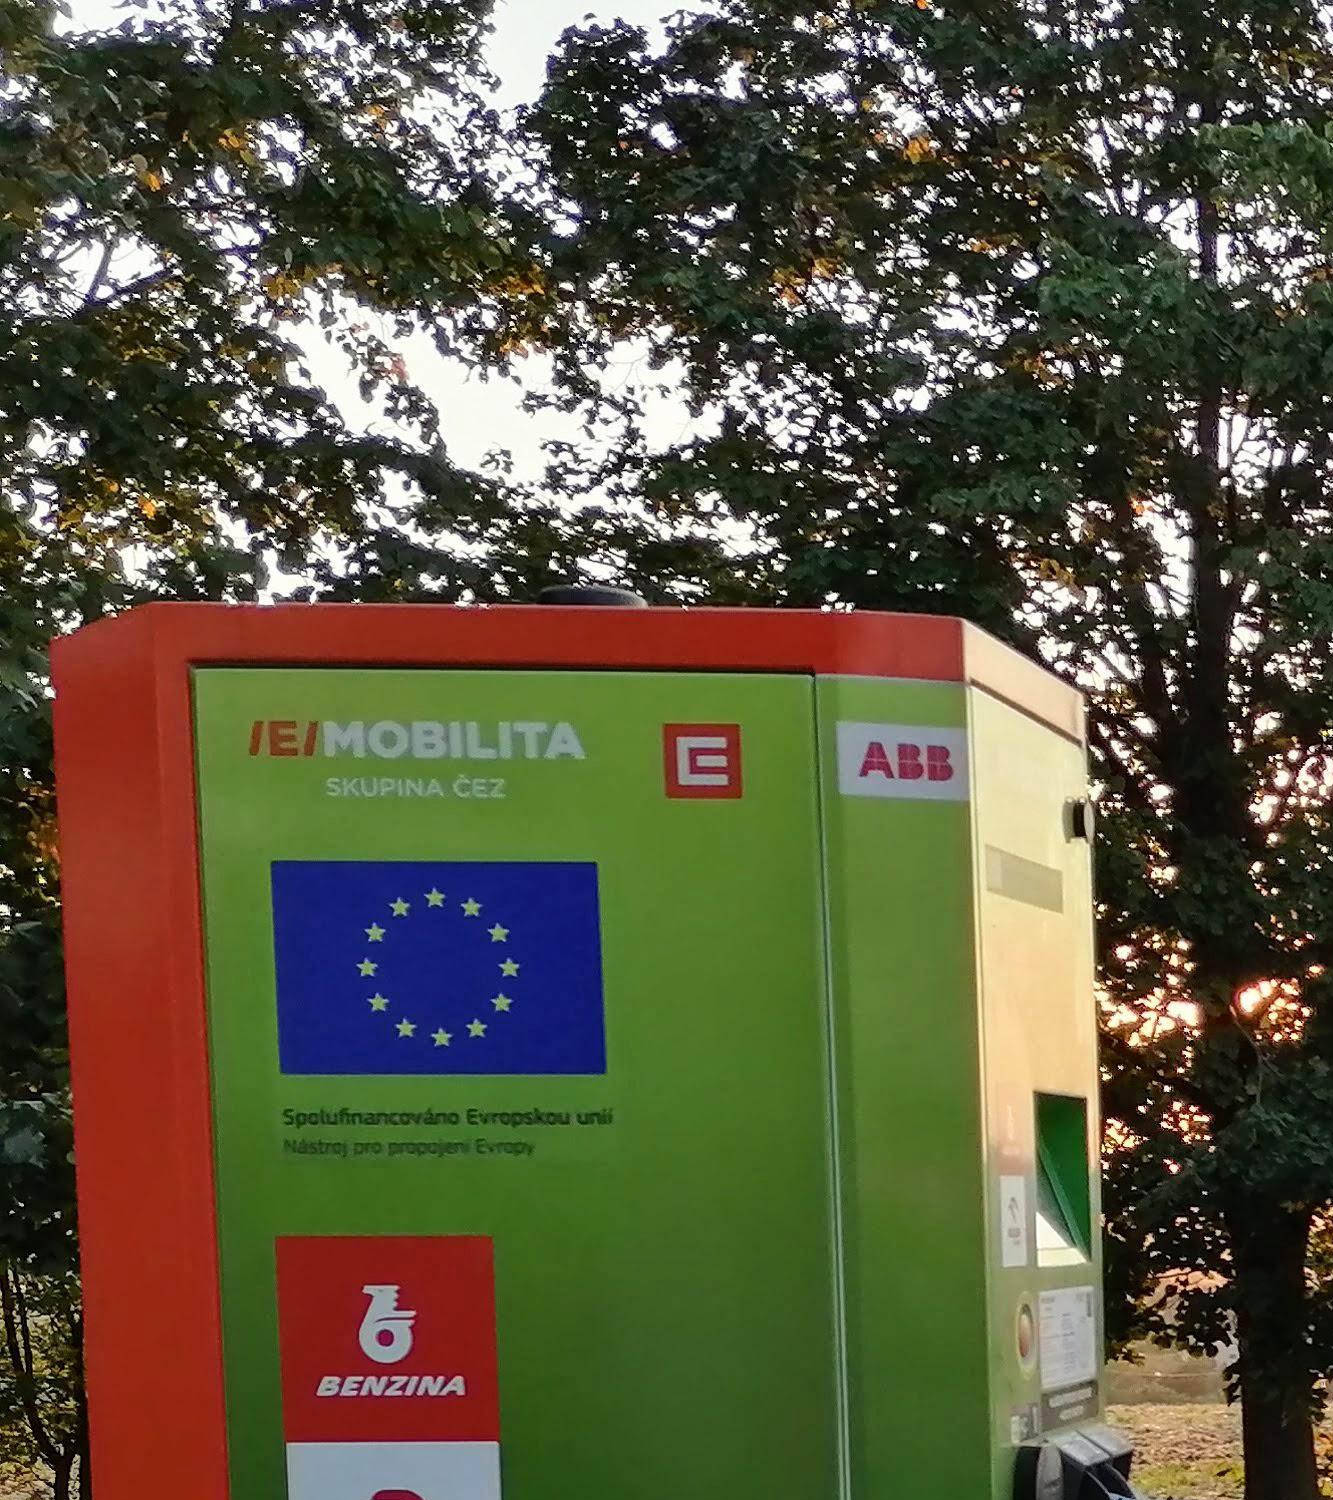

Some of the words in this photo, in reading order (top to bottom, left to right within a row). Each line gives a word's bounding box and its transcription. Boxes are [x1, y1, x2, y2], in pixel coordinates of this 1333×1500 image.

[858, 741, 955, 781] ABB
[326, 777, 444, 797] SKUPINA
[452, 774, 506, 798] ČEZ
[282, 1108, 460, 1129] Spolufinancováno
[466, 1108, 570, 1129] Evropskou
[283, 1138, 348, 1157] Nástroj
[354, 1141, 382, 1156] pro
[476, 1138, 535, 1157] Evropy
[316, 1376, 467, 1397] BENZINA
